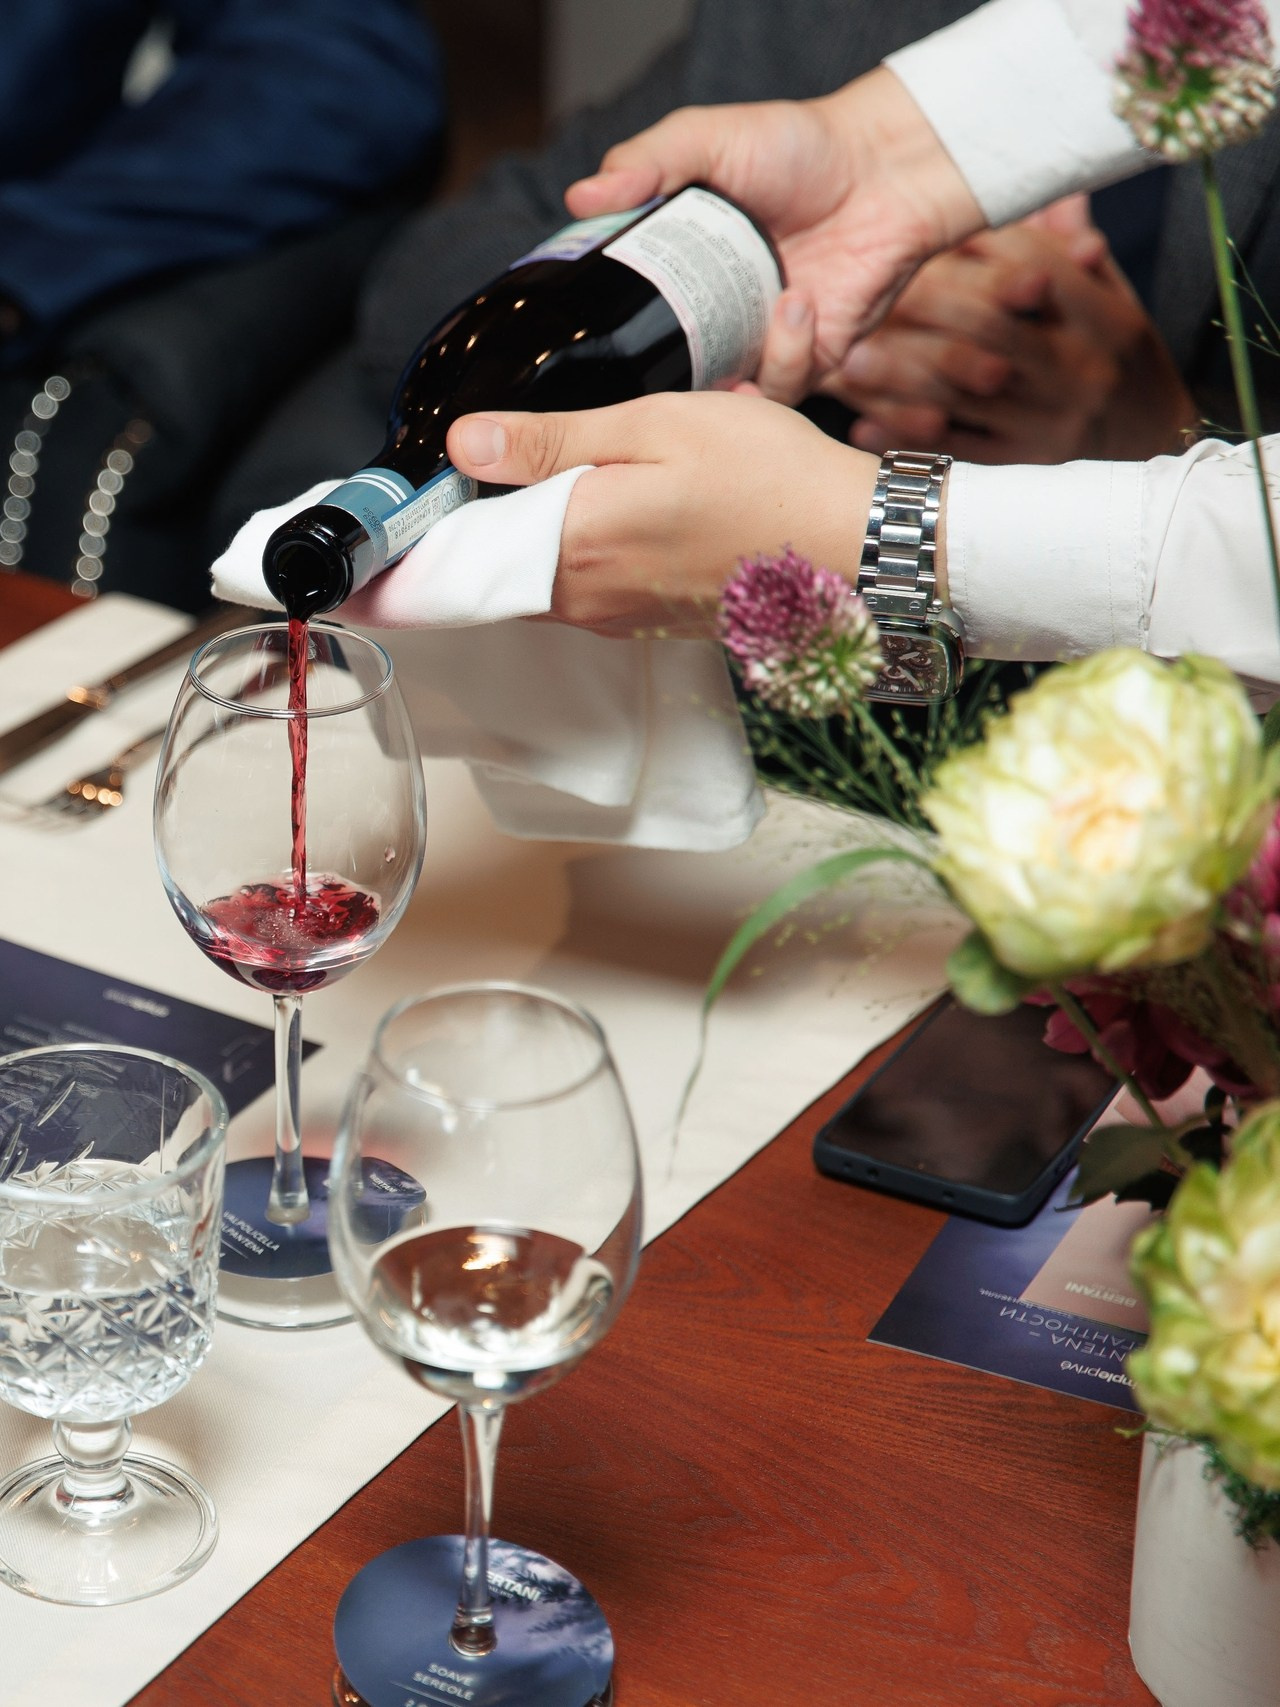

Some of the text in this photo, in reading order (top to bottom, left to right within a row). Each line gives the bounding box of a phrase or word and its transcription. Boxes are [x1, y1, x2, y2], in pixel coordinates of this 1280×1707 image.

[222, 1211, 281, 1252] VALPOLICELLA
[1063, 1280, 1138, 1308] BERTANI
[1049, 1331, 1128, 1363] NTENA
[486, 1572, 542, 1601] ERTANI
[412, 1672, 474, 1701] SEREOLE
[429, 1663, 474, 1686] SOAVE
